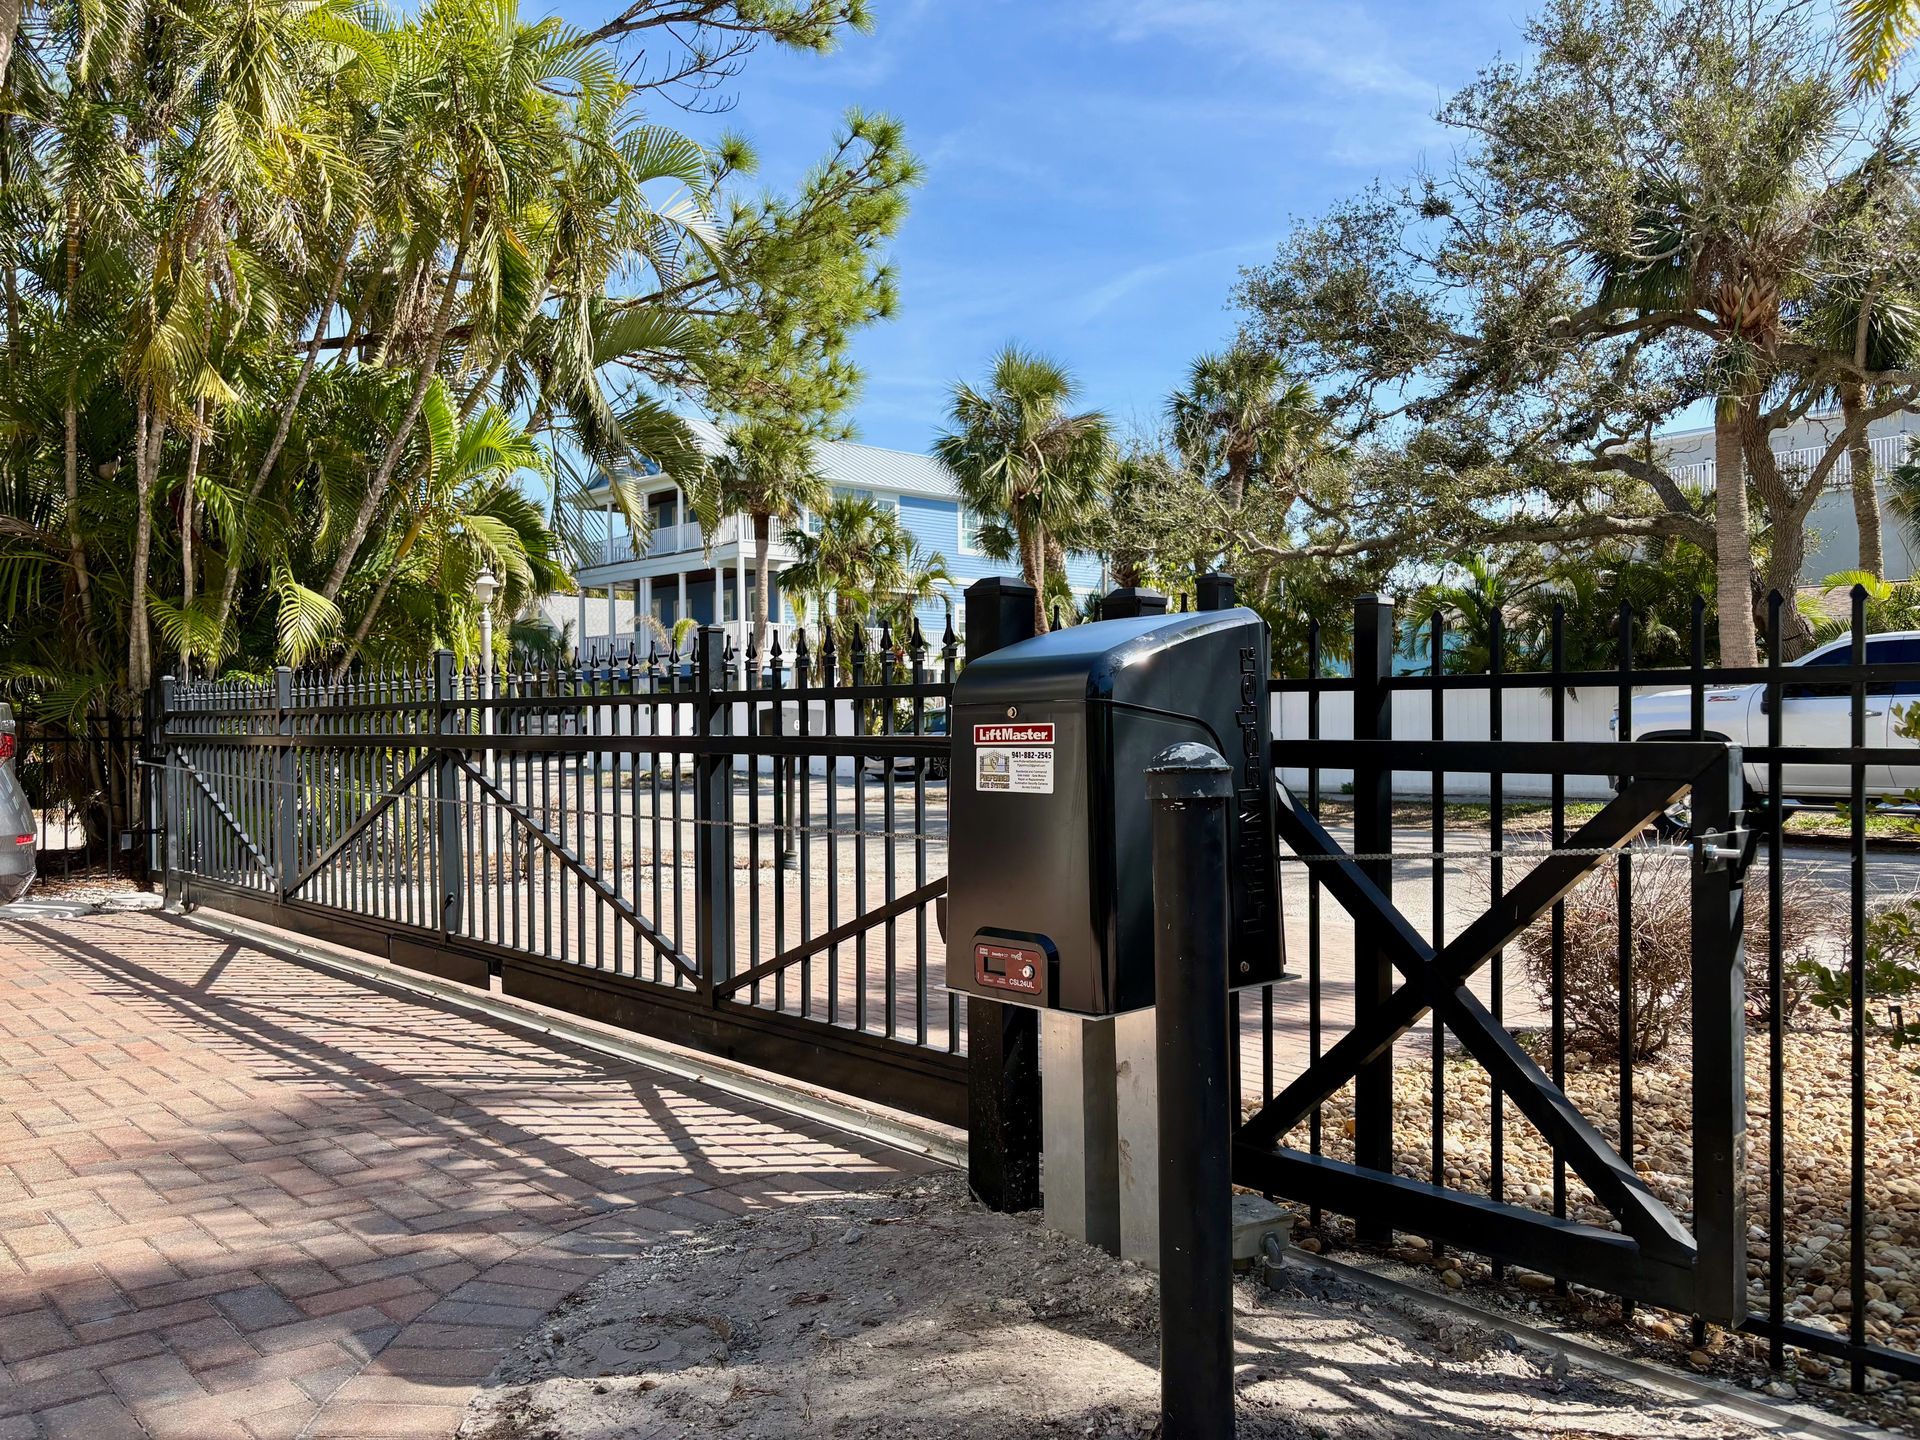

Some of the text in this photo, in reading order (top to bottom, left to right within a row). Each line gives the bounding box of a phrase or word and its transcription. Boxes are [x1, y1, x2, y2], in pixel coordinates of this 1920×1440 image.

[979, 727, 1048, 741] LiftMaster
[1011, 751, 1052, 759] 941-882-2545
[1009, 978, 1034, 989] CSL24UL
